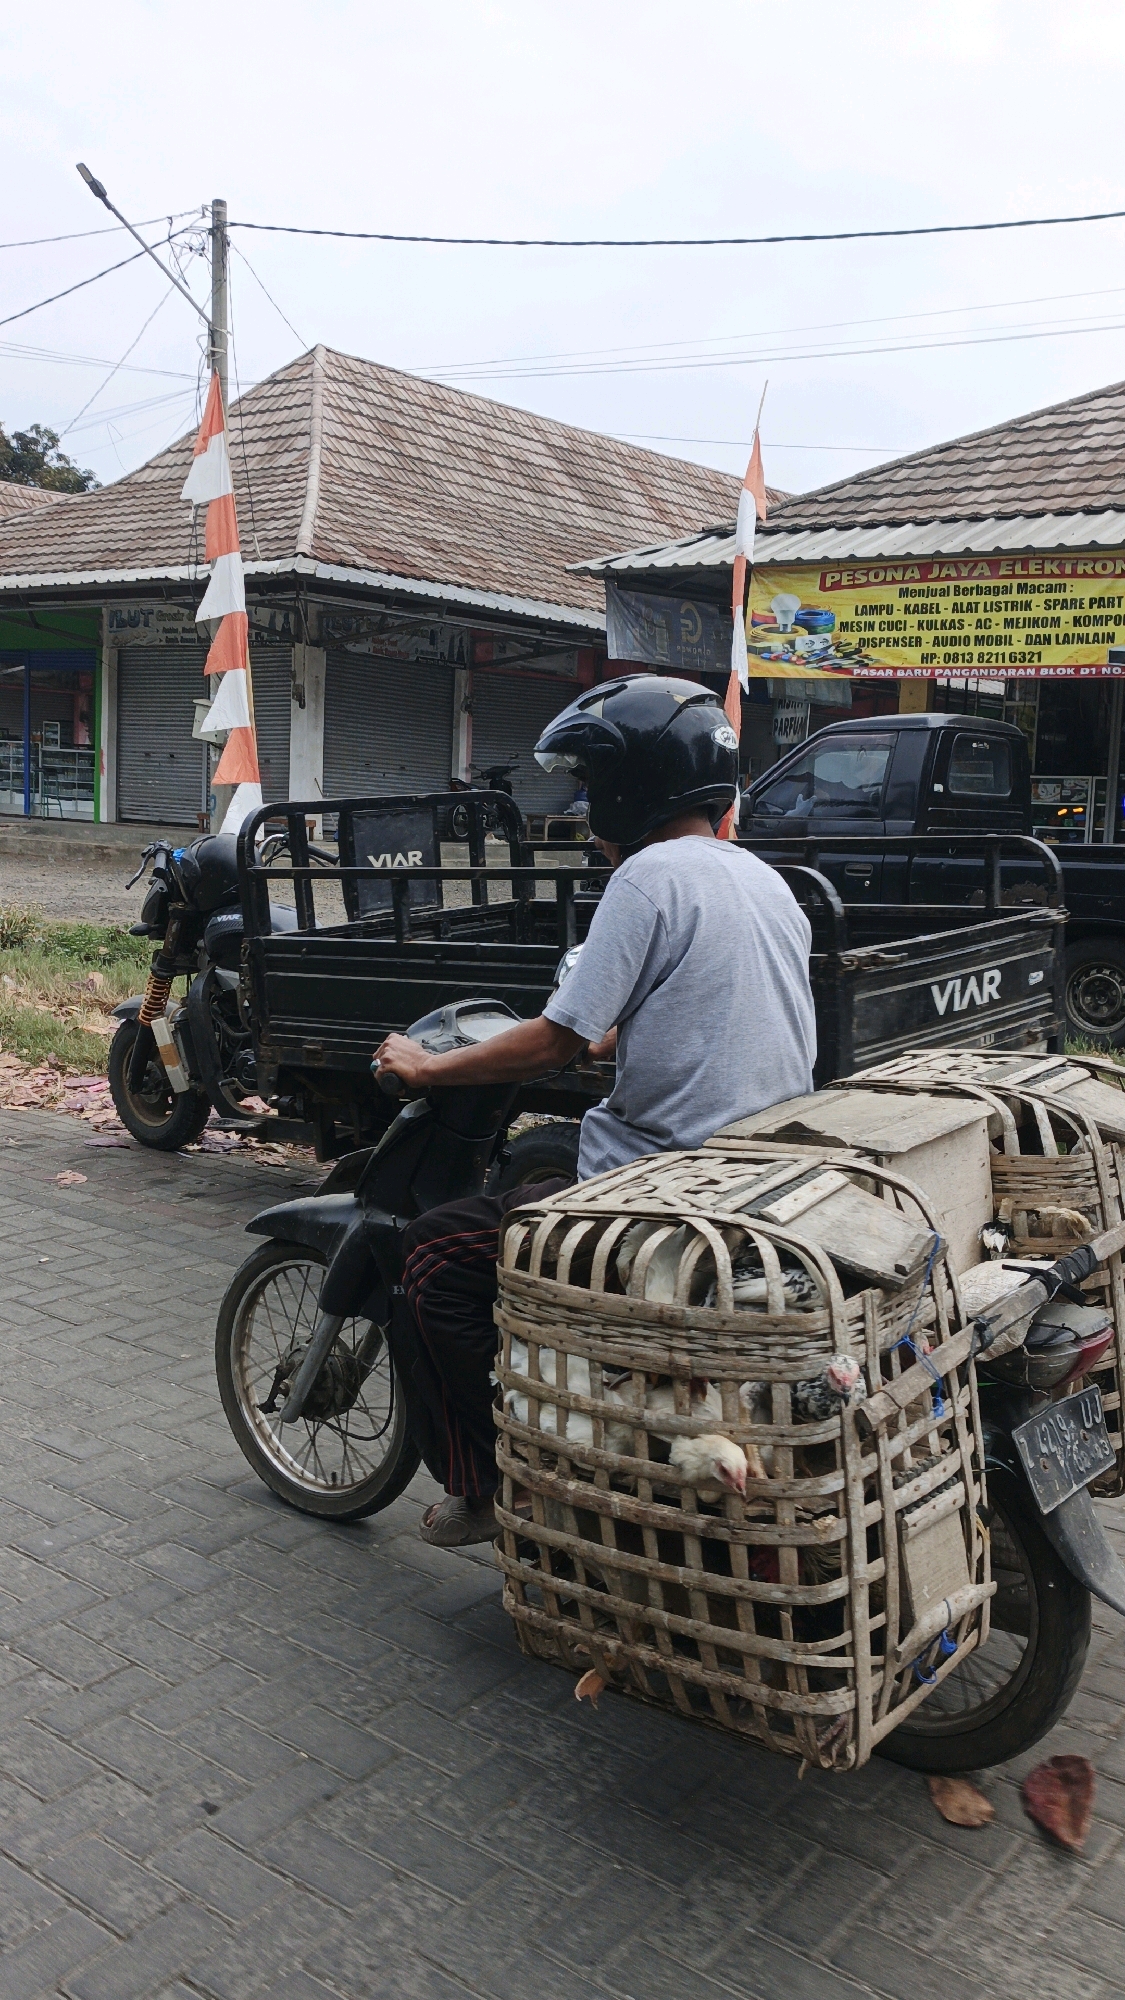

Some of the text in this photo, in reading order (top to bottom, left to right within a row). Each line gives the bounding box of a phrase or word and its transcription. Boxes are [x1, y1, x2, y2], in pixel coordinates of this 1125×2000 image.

[825, 565, 921, 588] PESONA
[927, 561, 991, 579] JAYA
[898, 585, 950, 599] Menjual
[953, 583, 1013, 597] Berbagai
[1016, 582, 1067, 594] Macam
[854, 603, 894, 617] LAMPU
[903, 602, 941, 615] KABEL
[951, 601, 980, 614] ALAT
[983, 599, 1033, 613] LISTRIK
[1043, 597, 1085, 611] SPARE
[1088, 596, 1124, 609] PART
[839, 620, 876, 632] MESIN
[878, 619, 907, 632] CUCI
[917, 618, 965, 631] KULKAS
[974, 618, 992, 630] AC
[1003, 616, 1061, 629] MEJIKOM
[1072, 614, 1125, 628] KOMPO
[858, 636, 923, 648] DISPENSER
[932, 635, 970, 648] AUDIO
[973, 634, 1014, 647] MOBIL
[1024, 633, 1051, 646] DAN
[920, 652, 940, 665] HP:
[943, 651, 973, 664] 0813
[853, 668, 894, 677] PASAR
[896, 668, 931, 677] BARU
[934, 667, 1036, 676] PANGANDARAN
[1040, 667, 1075, 676] BLOK
[1080, 667, 1096, 675] D1
[774, 716, 807, 738] PARFUM
[366, 850, 423, 868] VIAR
[930, 969, 1001, 1016] VIAR
[1080, 1394, 1102, 1429] UJ
